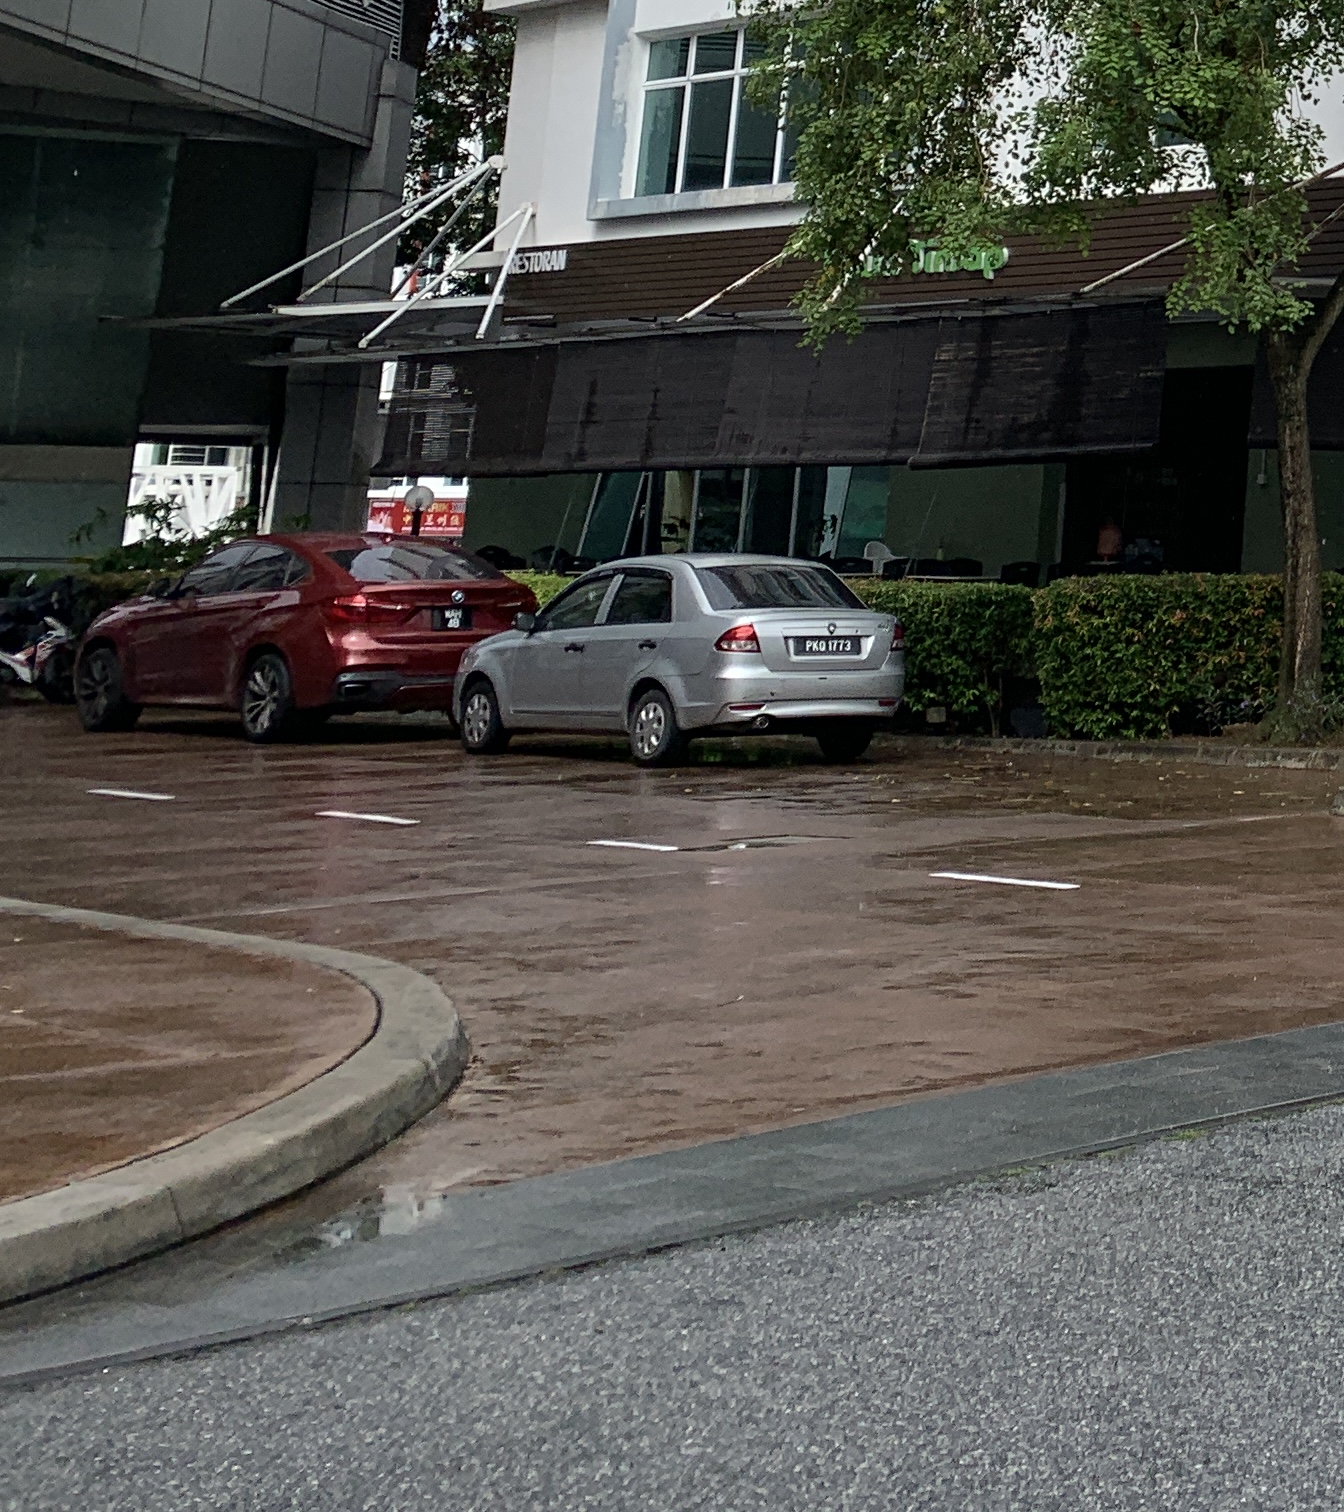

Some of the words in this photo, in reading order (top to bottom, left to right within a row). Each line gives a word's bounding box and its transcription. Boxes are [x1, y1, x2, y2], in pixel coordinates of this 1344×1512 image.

[506, 249, 567, 275] RESTORAN
[805, 640, 826, 652] PKQ
[828, 640, 851, 651] 1773
